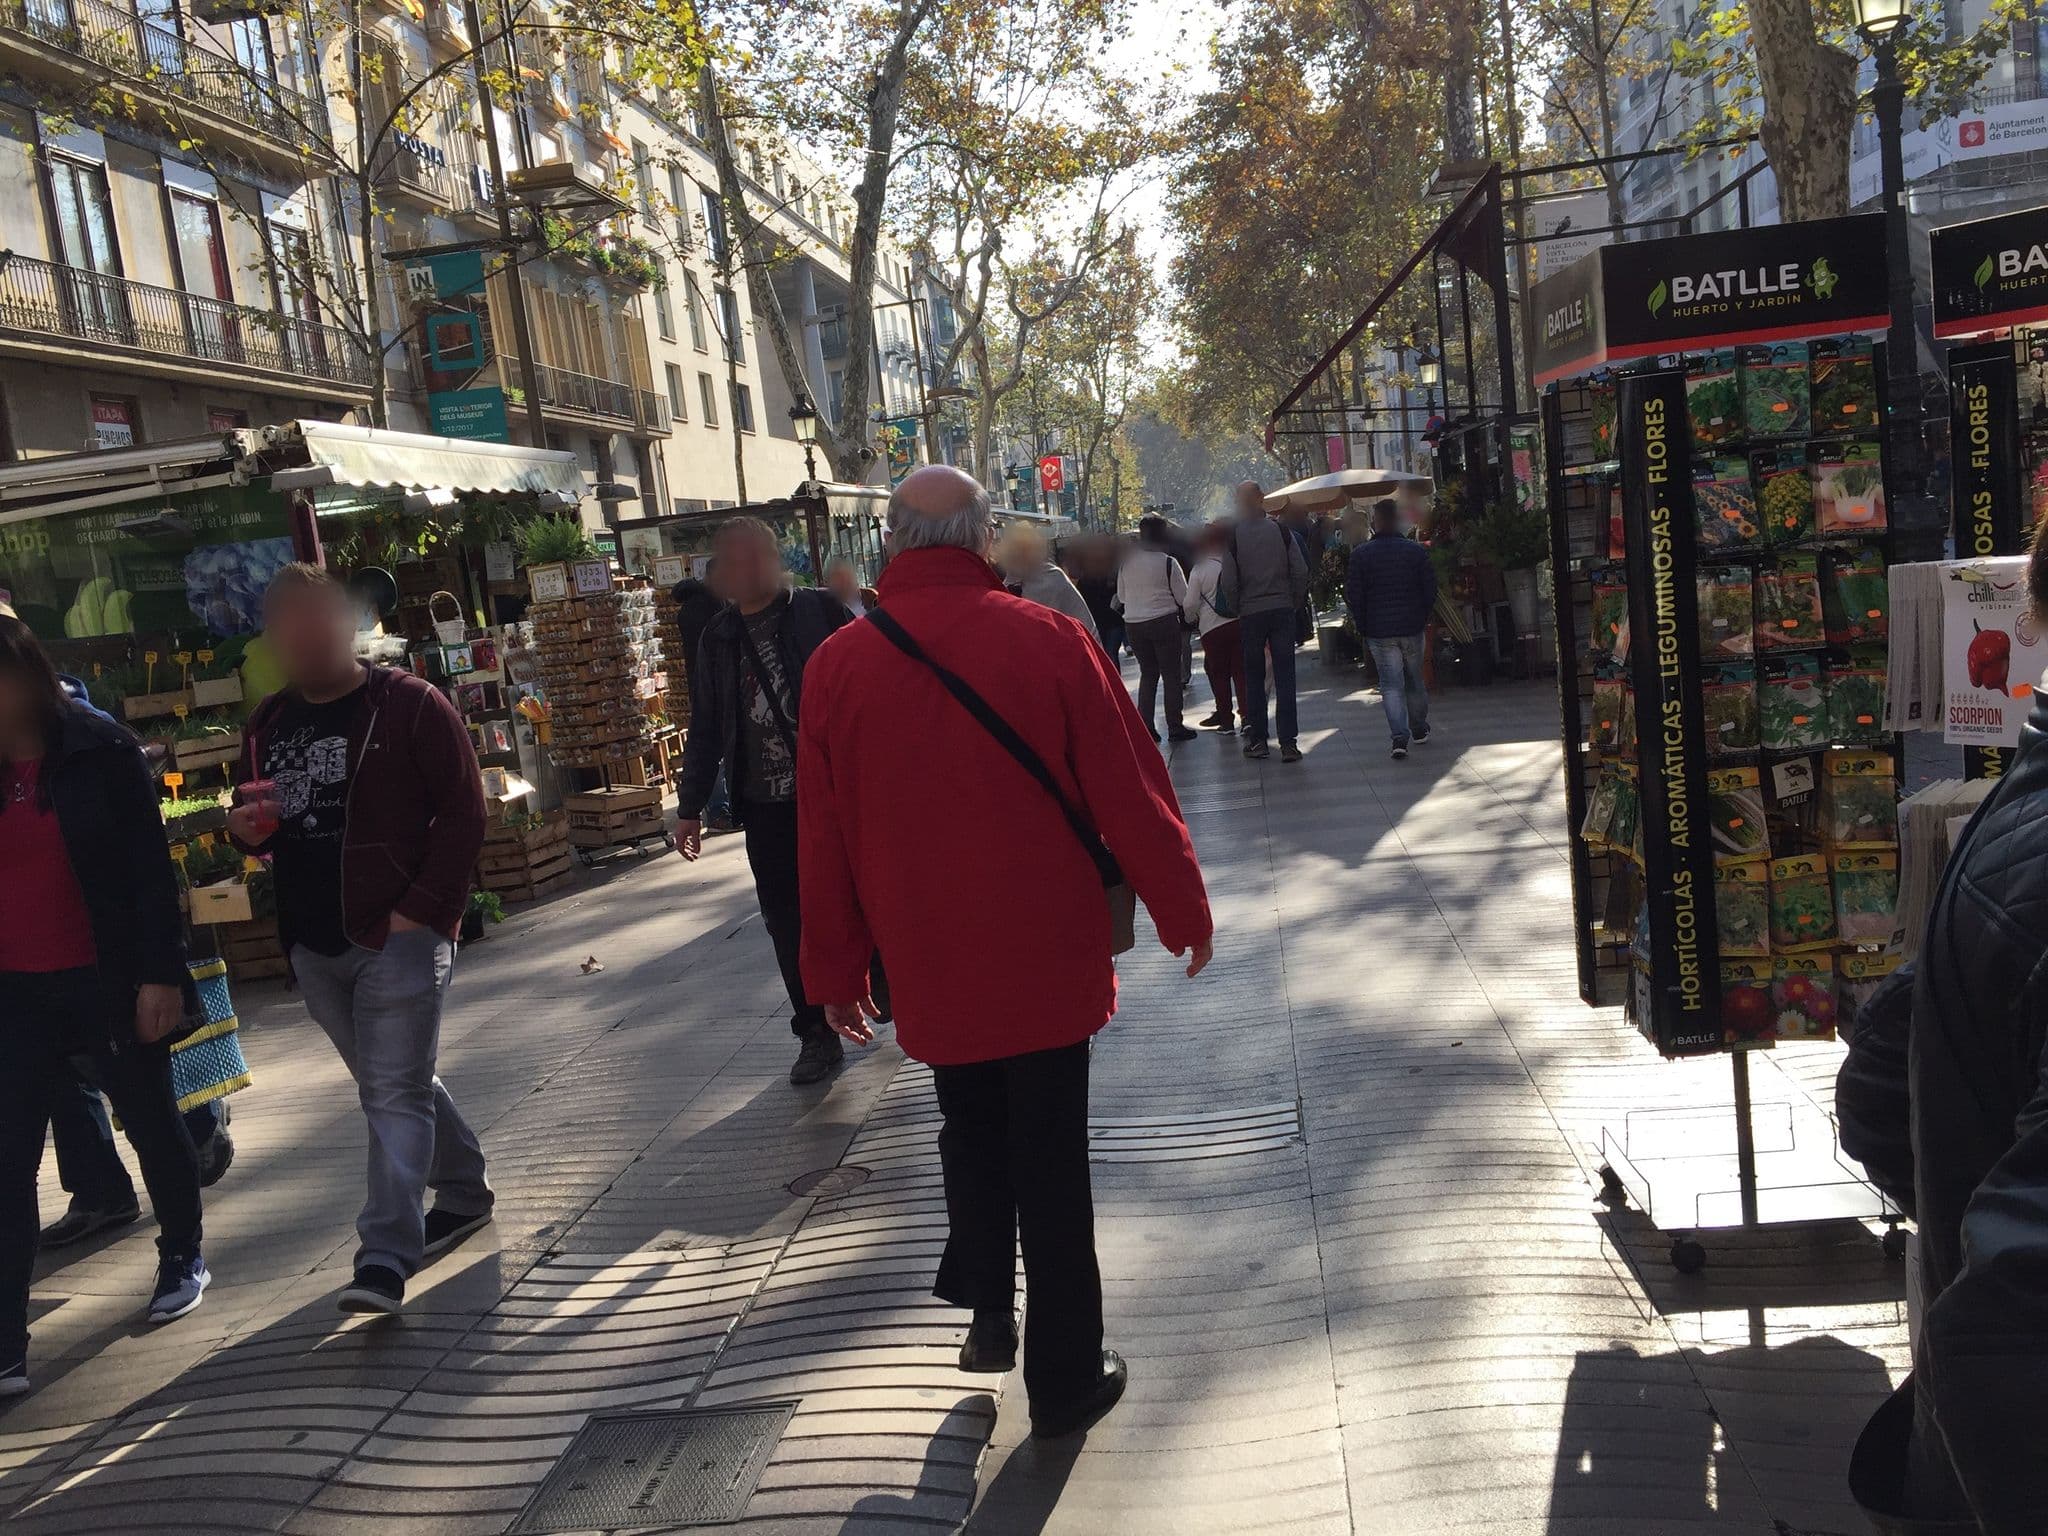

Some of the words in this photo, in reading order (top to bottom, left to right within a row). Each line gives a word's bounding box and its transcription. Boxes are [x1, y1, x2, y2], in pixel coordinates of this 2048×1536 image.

[1988, 115, 2045, 132] Ajuntament
[1989, 132, 2002, 141] de
[1671, 263, 1800, 304] BATLLE
[1673, 303, 1728, 318] HUERTO
[1735, 302, 1744, 310] Y
[1749, 293, 1801, 309] JARDÍN
[1547, 299, 1583, 338] BATLLE
[1968, 384, 1990, 468] FLORES
[1644, 398, 1668, 484] FLORES
[230, 511, 262, 525] JARDIN
[1650, 506, 1679, 678] LEGUMINOSAS
[1950, 706, 2003, 726] SCORPION
[1962, 725, 1986, 733] ORGANIC
[1661, 700, 1690, 848] AROMÁTICAS
[1782, 794, 1809, 809] BATLLE
[1673, 870, 1701, 1011] HORTÍCOLAS
[1677, 1033, 1716, 1045] BATLLE
